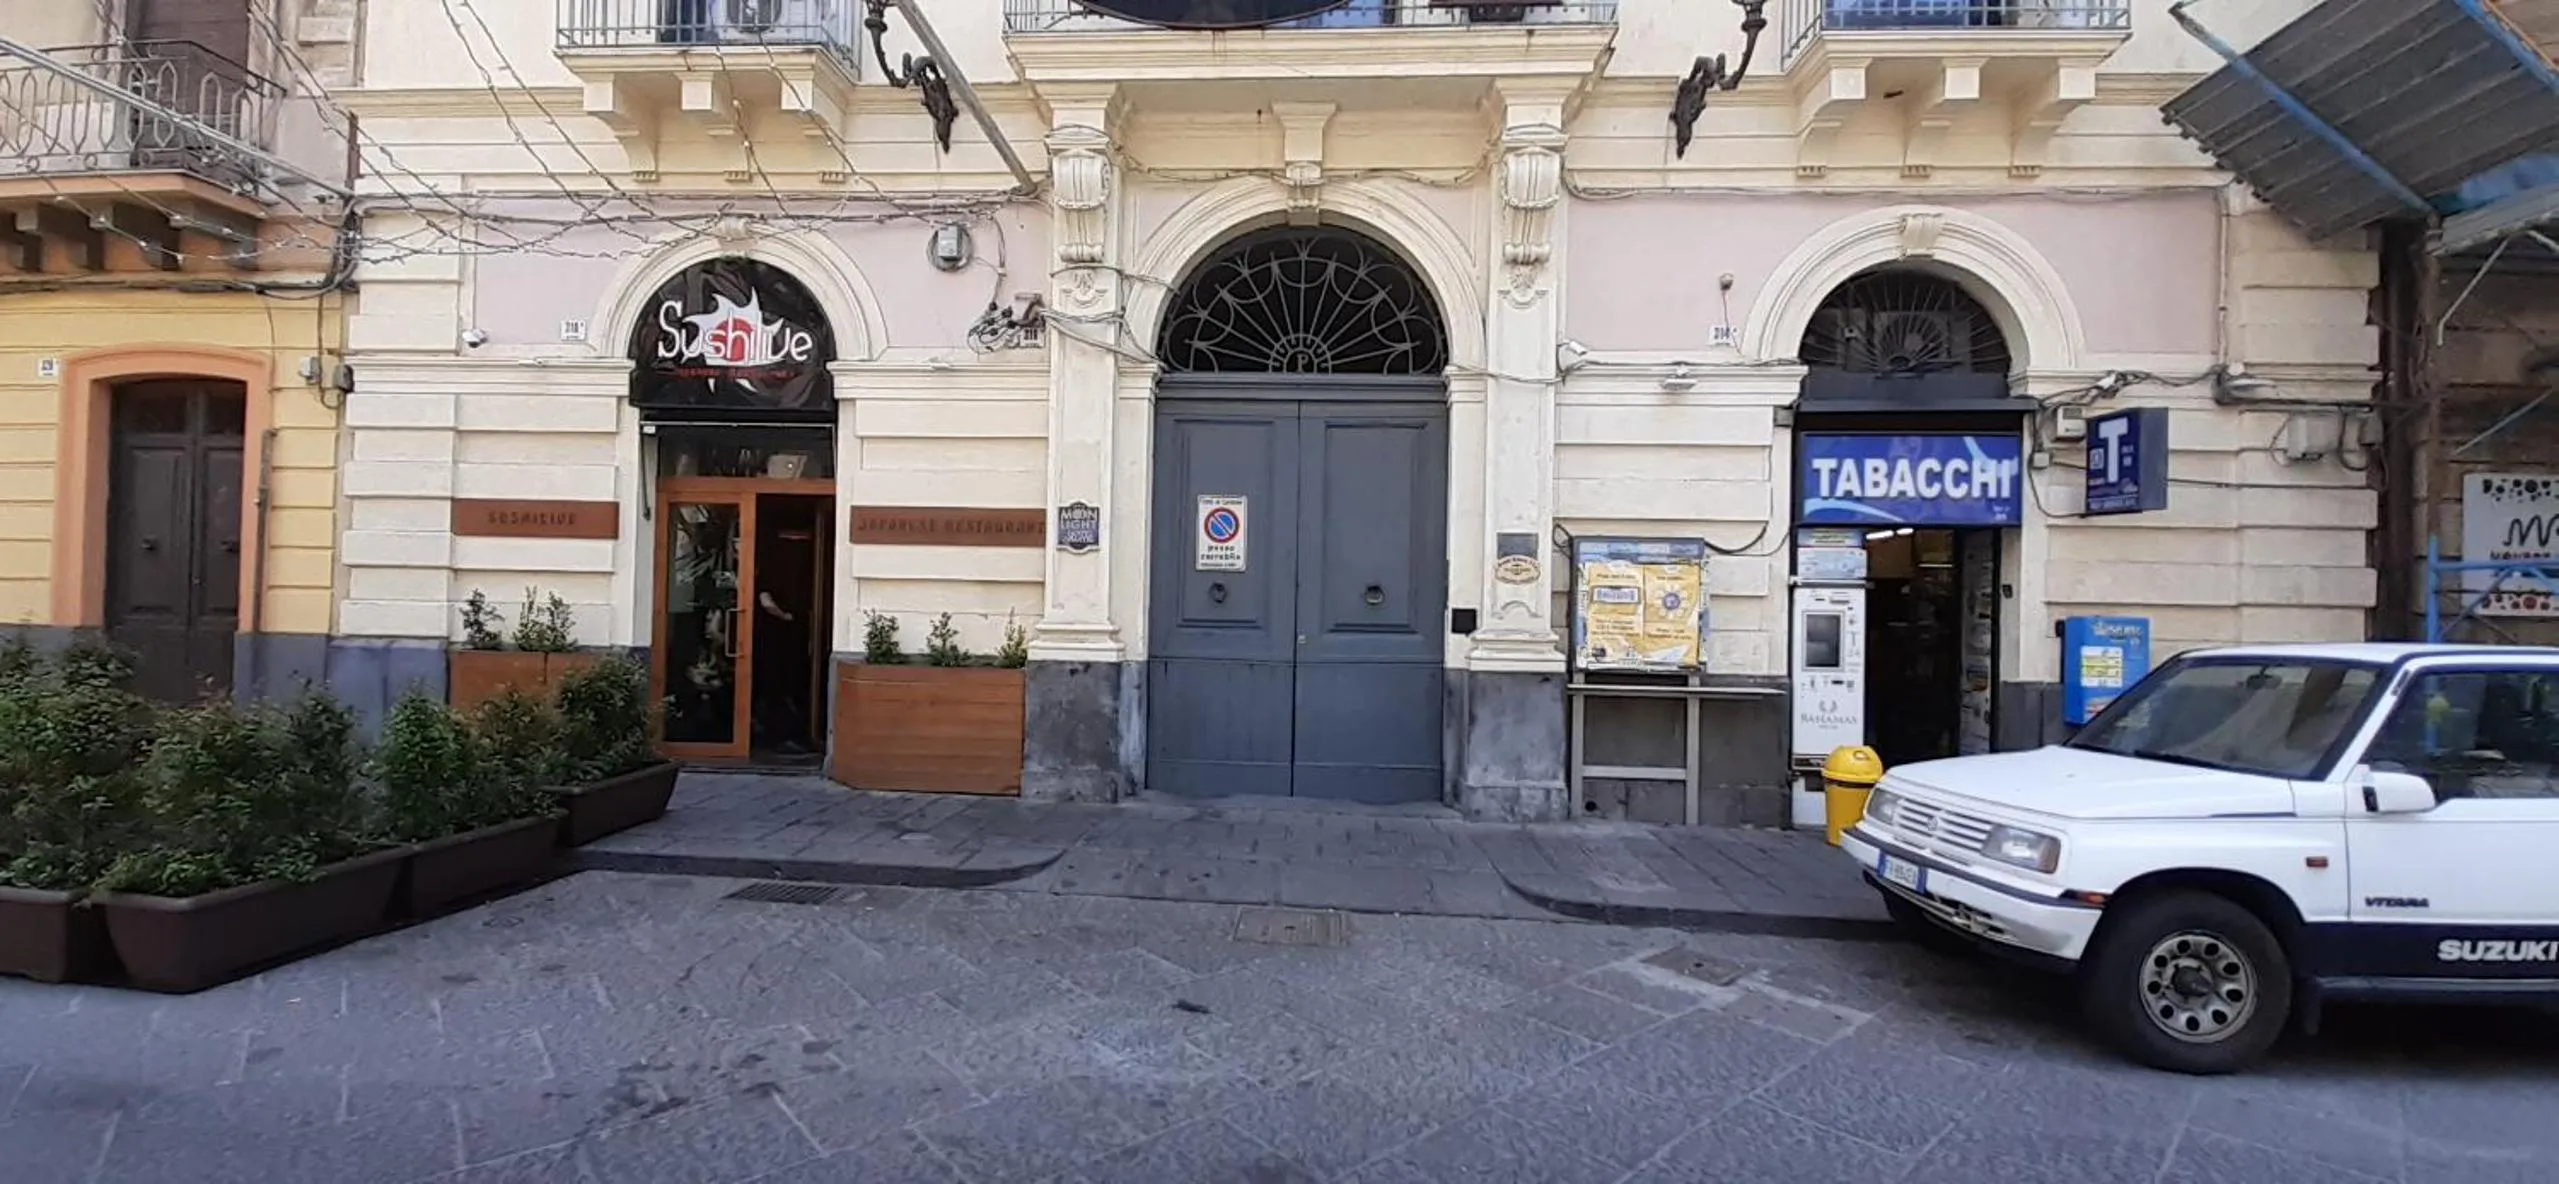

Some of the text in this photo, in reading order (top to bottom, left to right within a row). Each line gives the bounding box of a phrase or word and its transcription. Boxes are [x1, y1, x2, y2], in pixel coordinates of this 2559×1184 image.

[2098, 416, 2128, 483] T
[1812, 457, 2012, 499] TABACCHI
[1801, 713, 1857, 725] BAHAMAS
[2364, 896, 2430, 908] VITARA
[2437, 938, 2559, 962] SUZUKI
